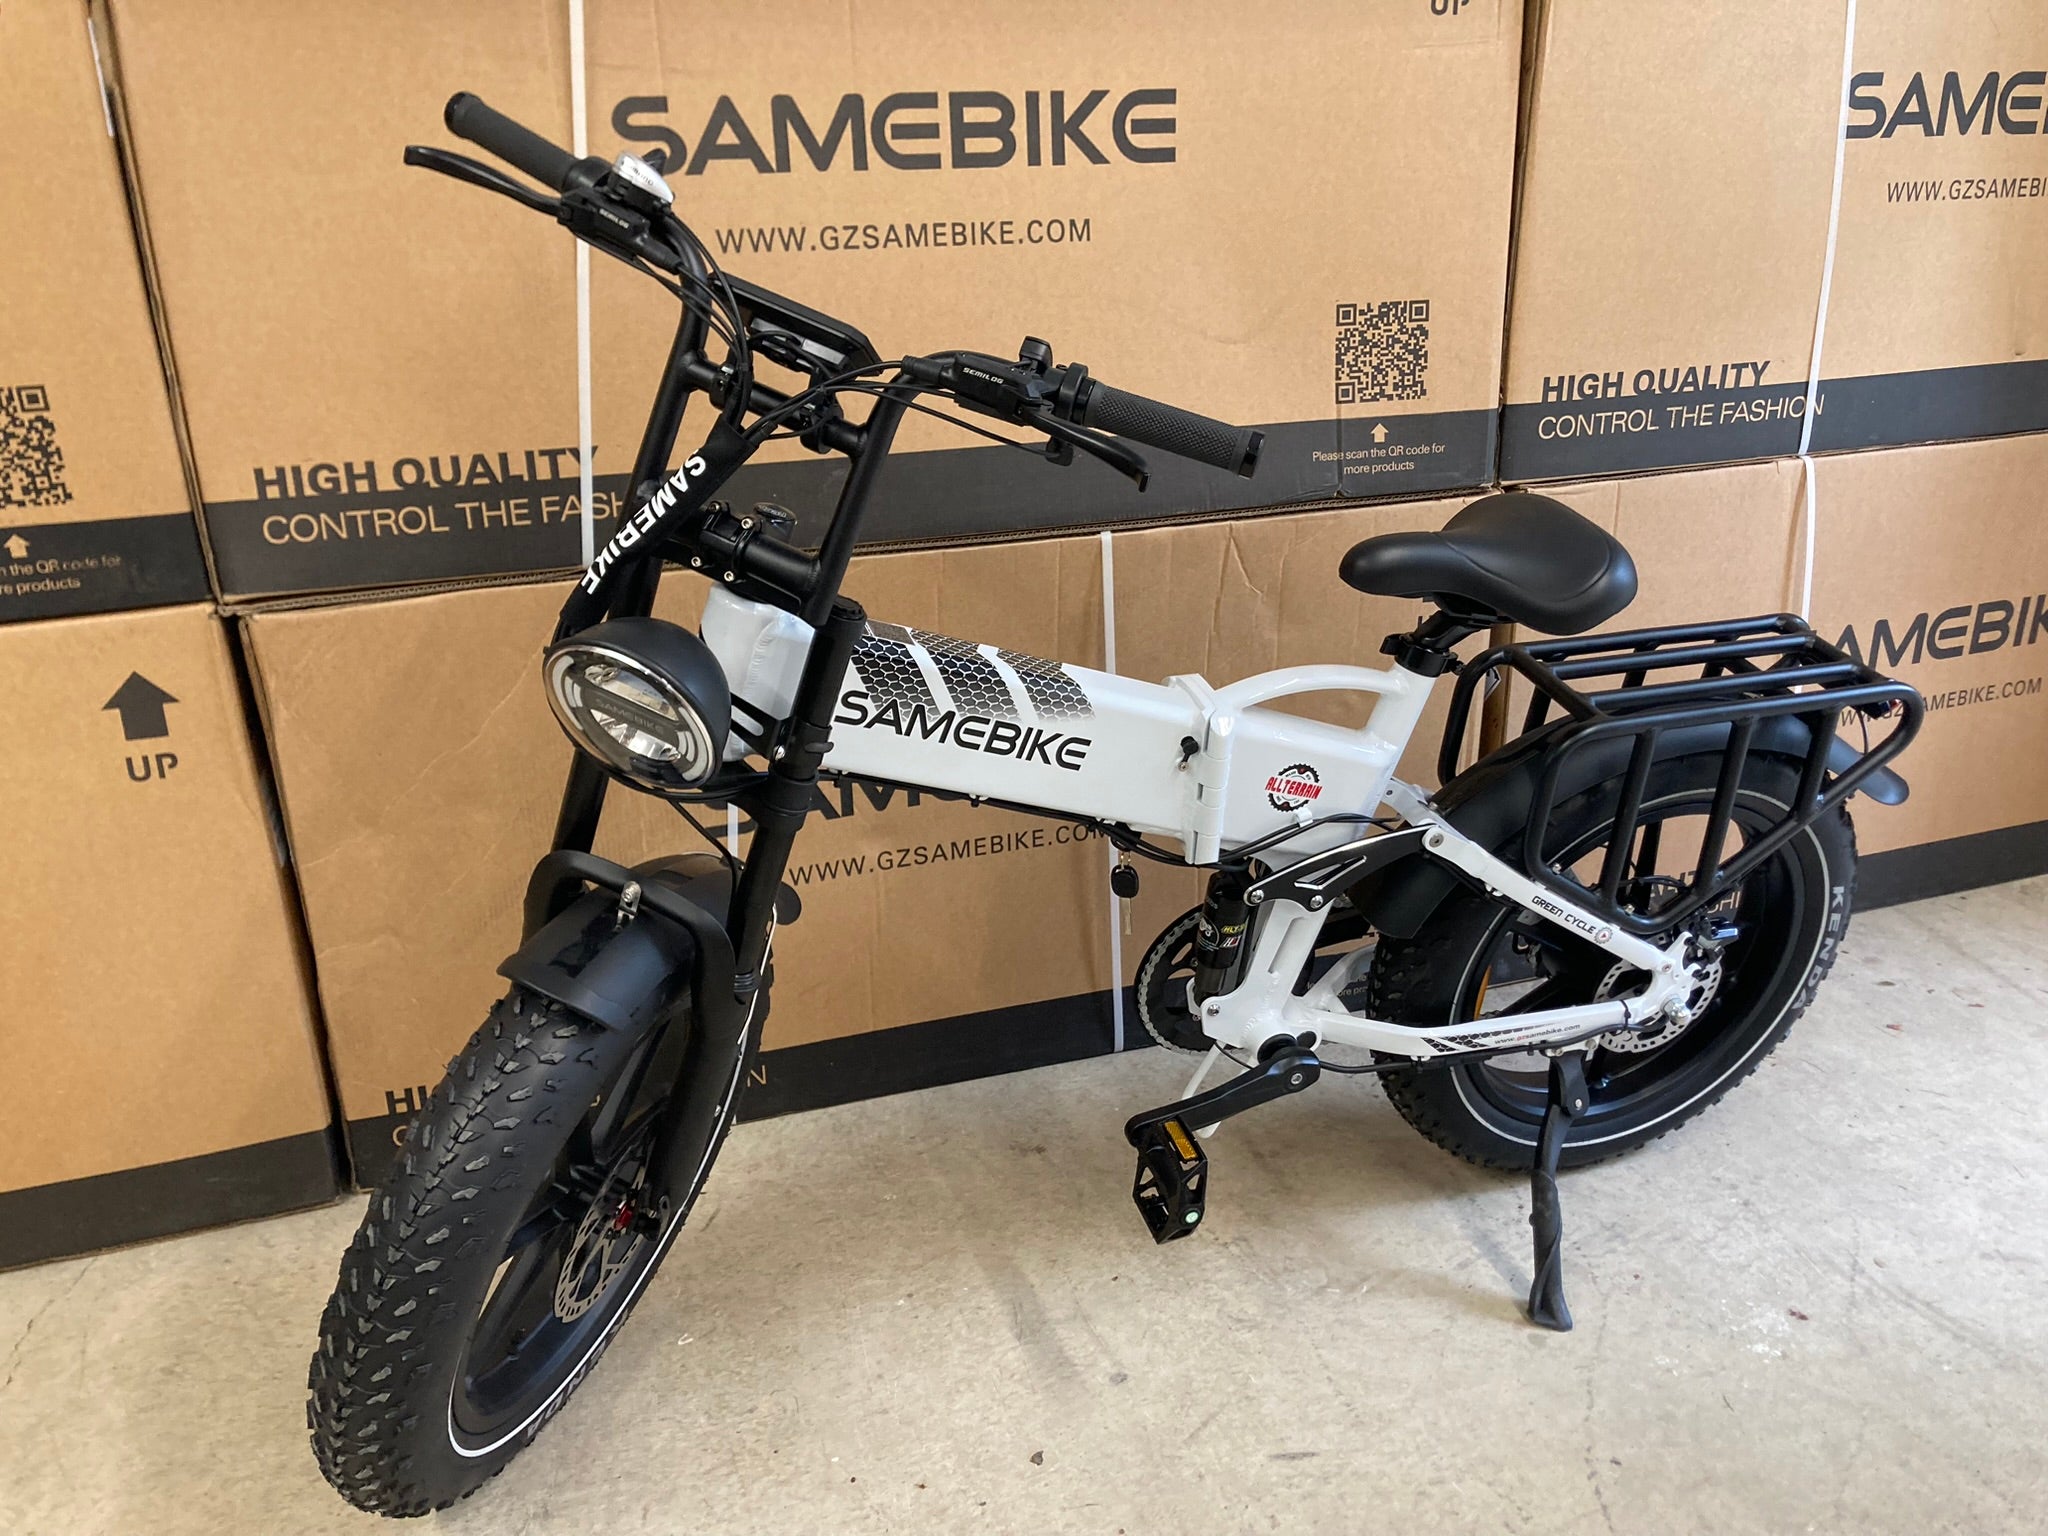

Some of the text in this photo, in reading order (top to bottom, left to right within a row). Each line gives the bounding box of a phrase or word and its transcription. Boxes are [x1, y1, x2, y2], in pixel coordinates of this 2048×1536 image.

[1846, 71, 2048, 139] SAME
[611, 89, 1177, 176] SAMEBIKE
[715, 218, 1092, 255] WWW.GZSAMEBIKE.COM
[1542, 360, 1771, 402] HIGH QUALITY
[1538, 394, 1825, 440] CONTROL THE FASHION
[253, 445, 598, 501] HIGH QUALITY
[1312, 443, 1446, 462] Please scan the QR code for
[1343, 460, 1415, 475] more products
[262, 506, 449, 545] CONTROL
[455, 498, 532, 530] THE
[9, 562, 34, 577] the
[16, 577, 81, 596] products
[834, 690, 1092, 771] SAMEBIKE
[125, 752, 178, 783] UP
[1531, 895, 1597, 935] GREEN CYCLE
